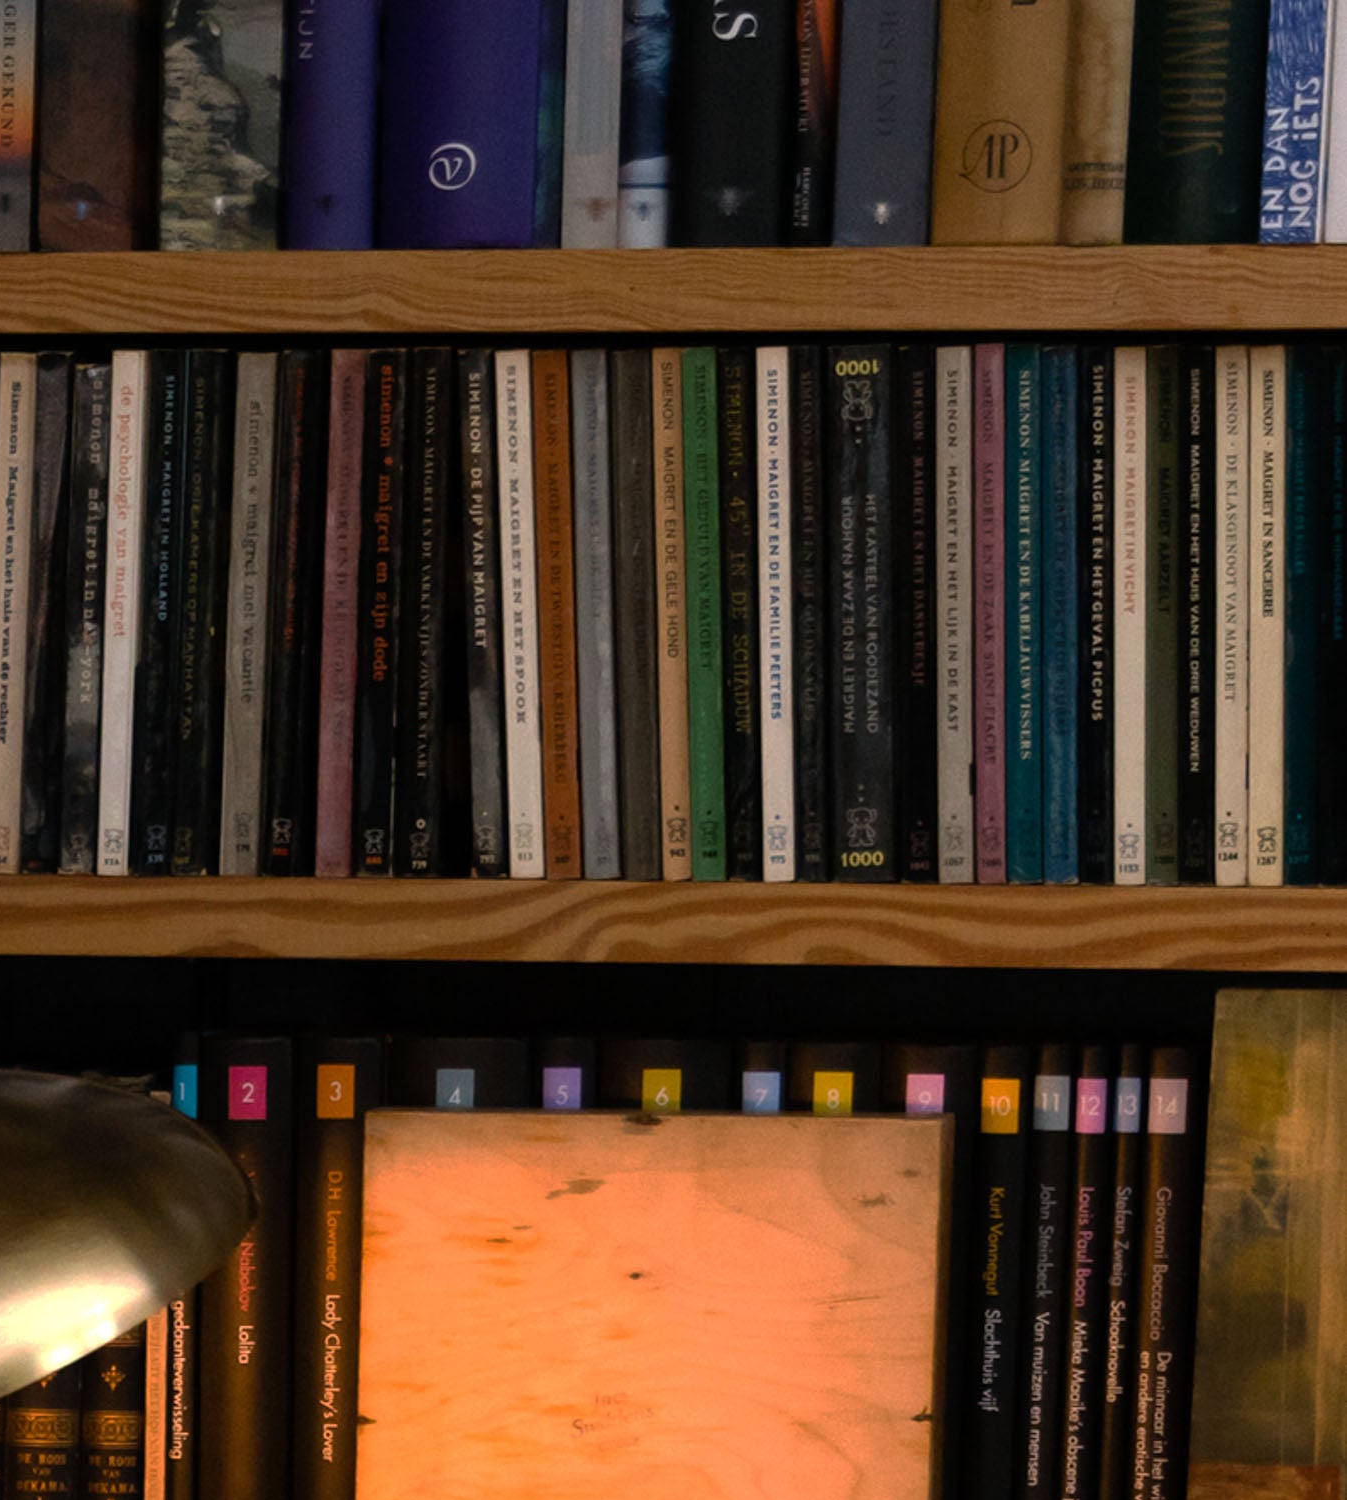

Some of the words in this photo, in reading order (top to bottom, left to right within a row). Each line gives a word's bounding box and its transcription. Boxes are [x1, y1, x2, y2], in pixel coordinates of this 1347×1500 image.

[1270, 107, 1289, 170] DAN
[1289, 159, 1314, 227] NOG
[1261, 203, 1280, 229] EN
[379, 365, 394, 448] simenon
[373, 474, 391, 553] maigret
[377, 561, 389, 584] en
[371, 592, 388, 630] zijn
[373, 636, 388, 682] dode
[985, 1187, 1005, 1220] Kurt
[983, 1223, 1003, 1296] Vonnegut
[319, 1294, 341, 1329] Lady
[238, 1325, 253, 1364] Lolita
[979, 1309, 1001, 1384] Slachthuis
[319, 1334, 342, 1419] Chatterley's
[978, 1388, 999, 1413] vijf
[321, 1425, 339, 1461] Lover
